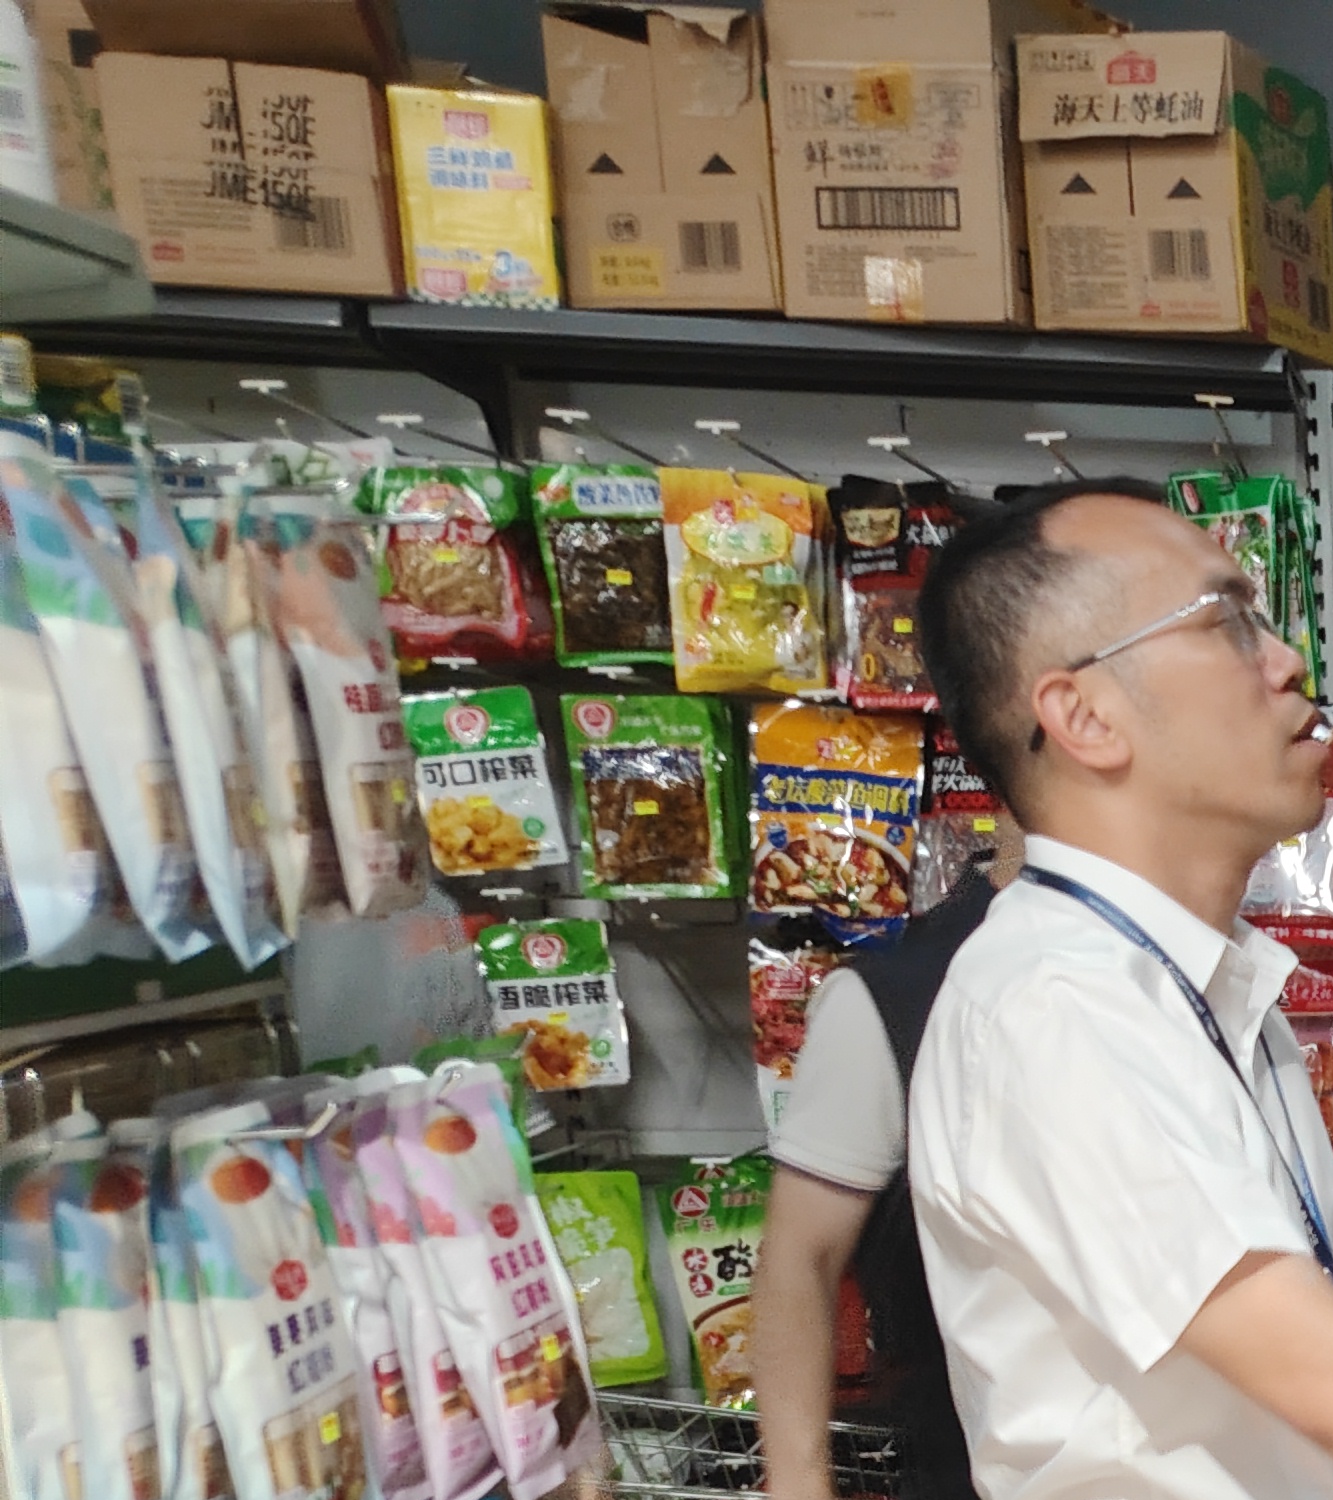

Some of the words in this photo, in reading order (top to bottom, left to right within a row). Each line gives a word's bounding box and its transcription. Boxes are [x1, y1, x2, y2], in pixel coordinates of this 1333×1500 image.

[1053, 92, 1204, 126] 海天上等蚝油
[421, 753, 538, 788] 可口榨菜
